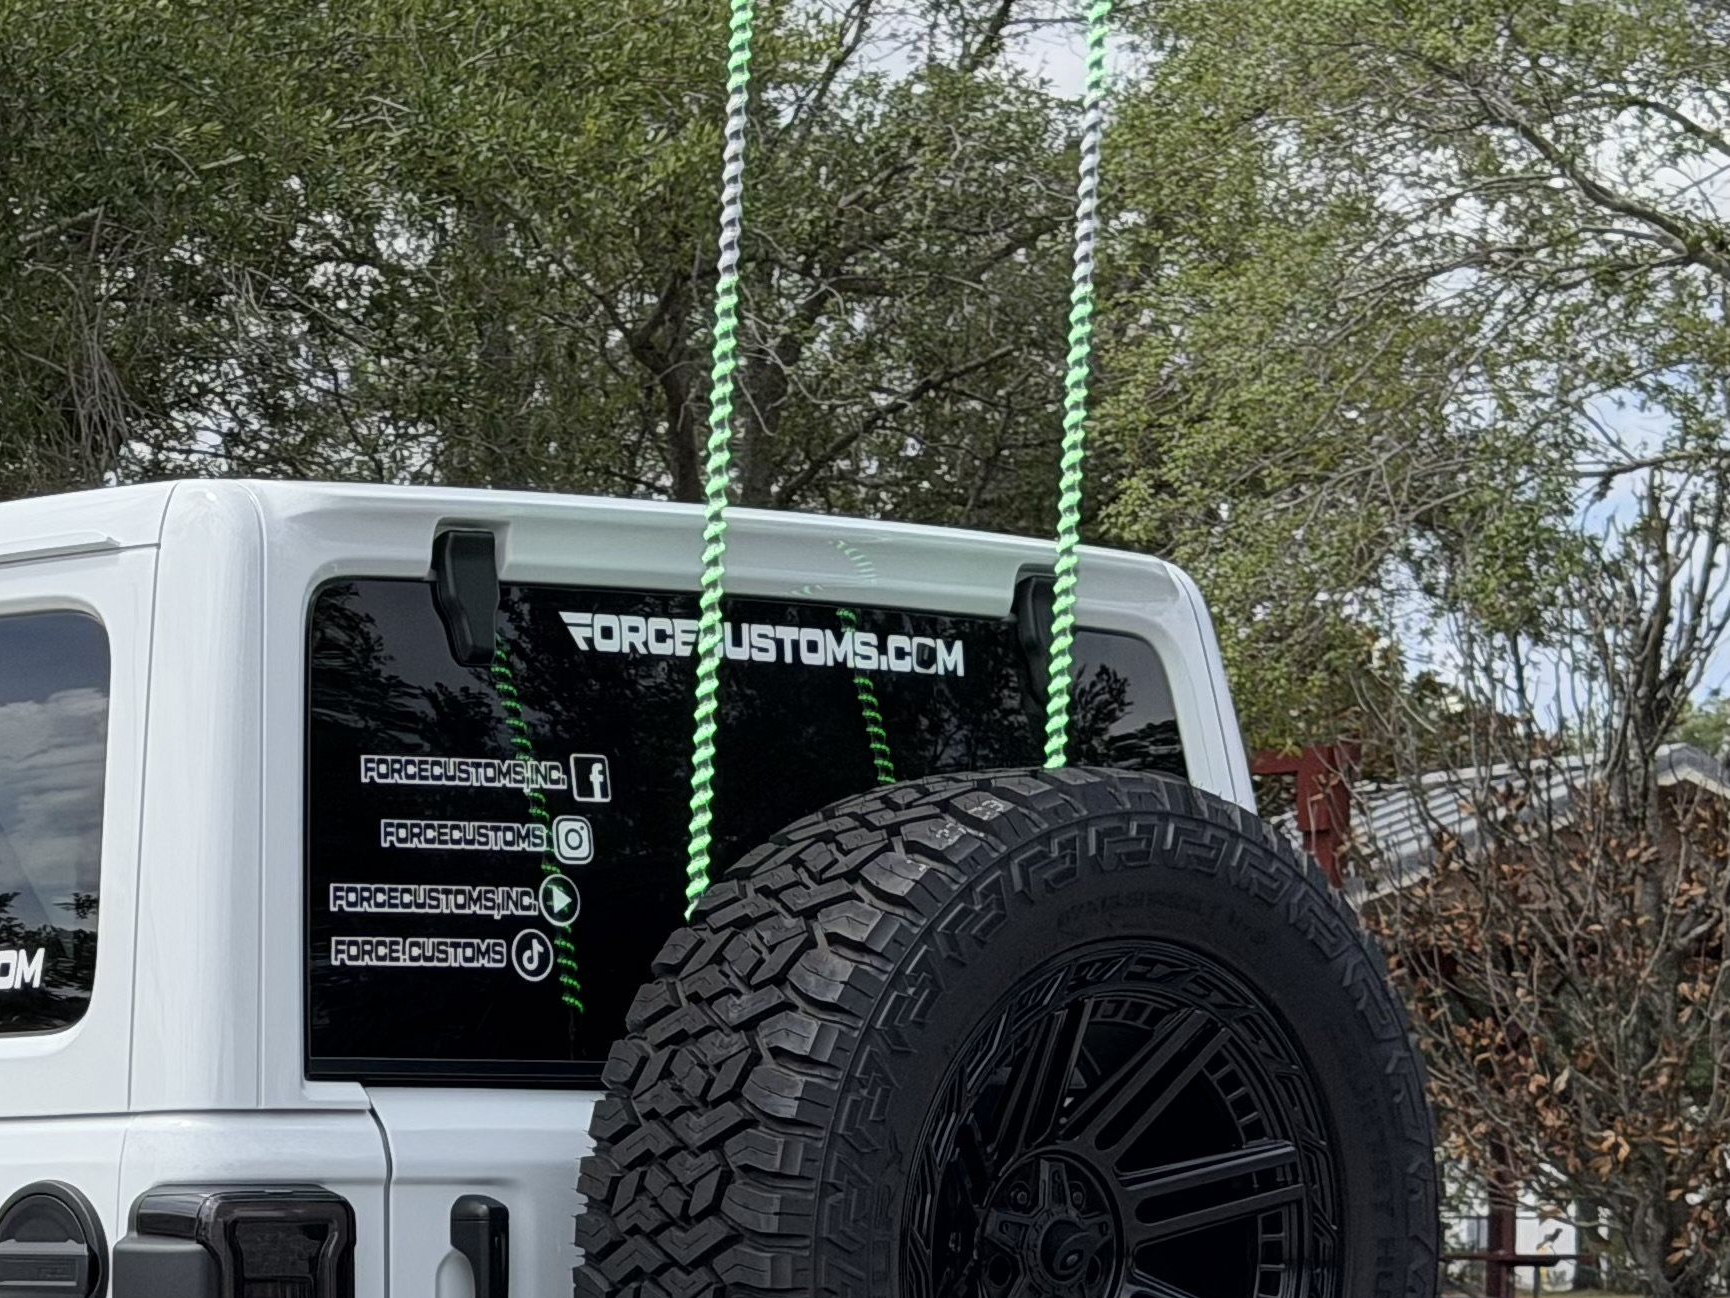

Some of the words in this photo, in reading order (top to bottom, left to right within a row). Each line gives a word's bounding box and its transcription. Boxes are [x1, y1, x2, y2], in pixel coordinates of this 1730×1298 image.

[558, 611, 965, 677] FORCEUSTOMS.COM
[381, 819, 547, 851] FORCECUSTOMS
[331, 937, 506, 967] FORCE.CUSTOMS
